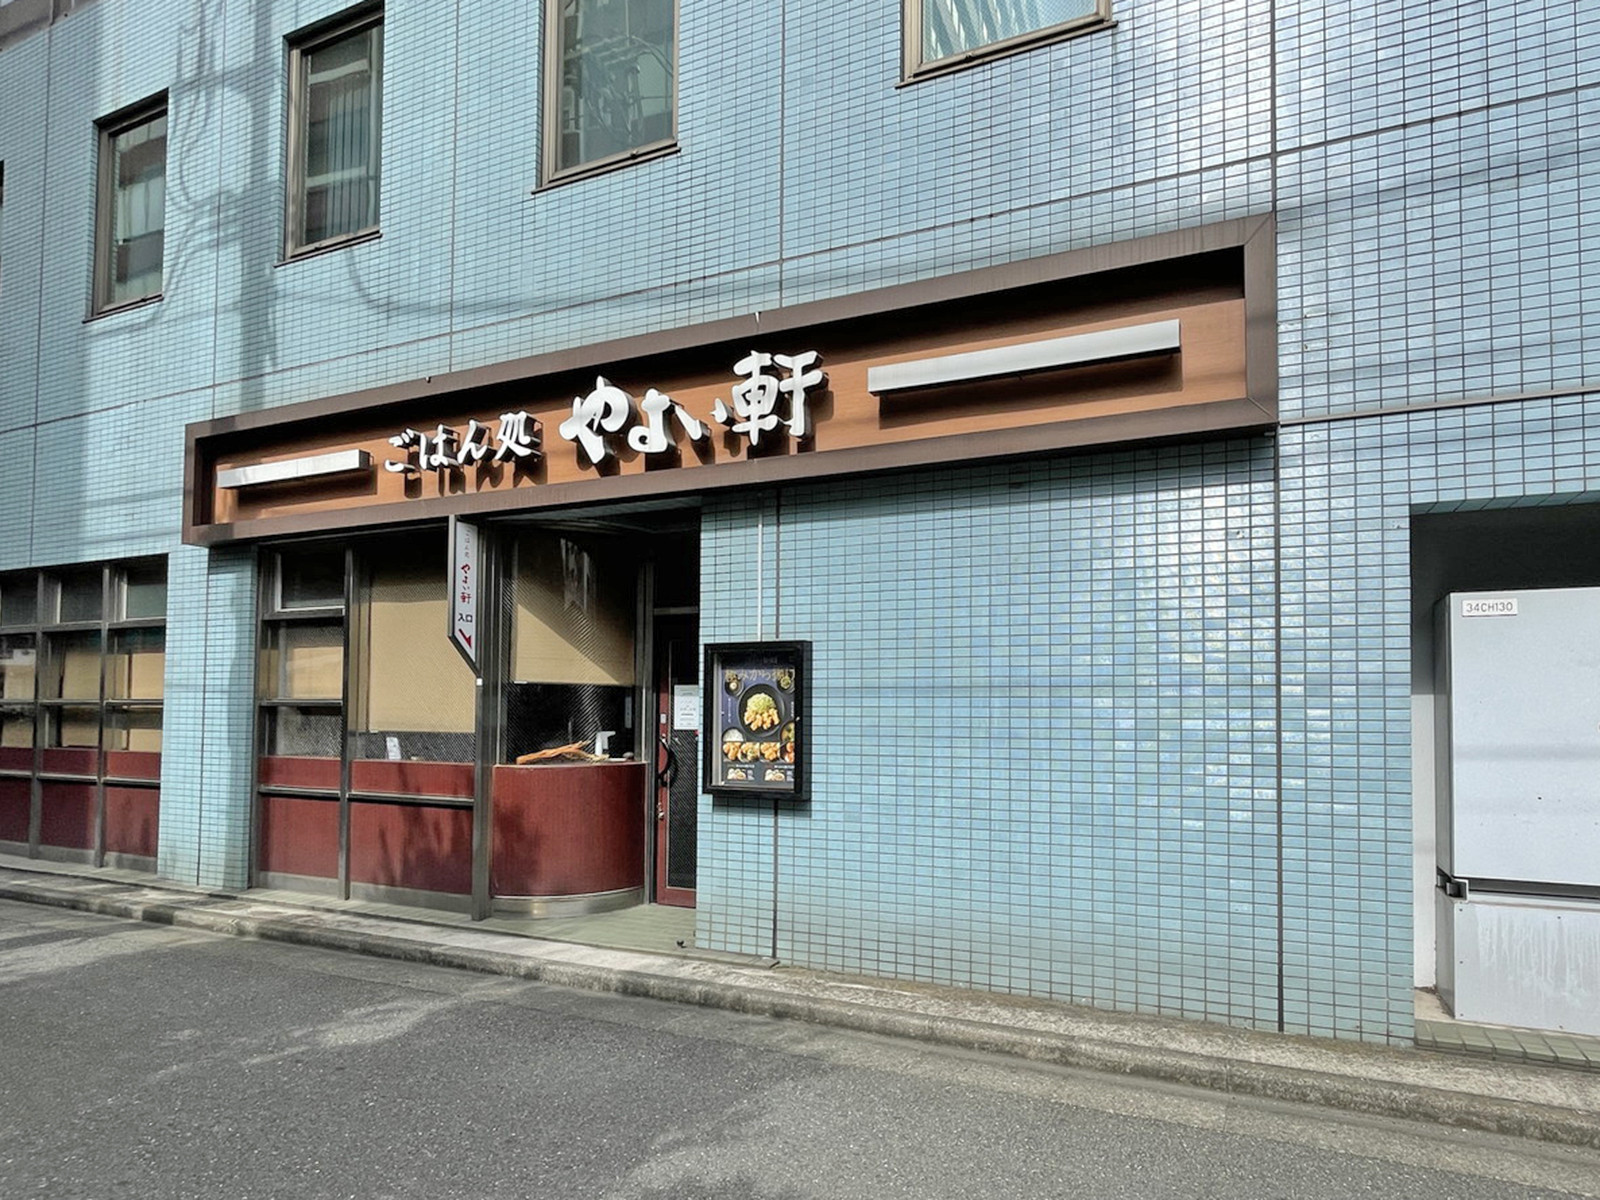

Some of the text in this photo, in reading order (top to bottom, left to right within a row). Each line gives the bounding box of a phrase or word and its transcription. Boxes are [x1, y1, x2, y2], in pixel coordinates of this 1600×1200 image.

[384, 350, 826, 473] ごはん処 やよい軒
[1466, 601, 1513, 613] 34CH130
[458, 613, 473, 623] 入口
